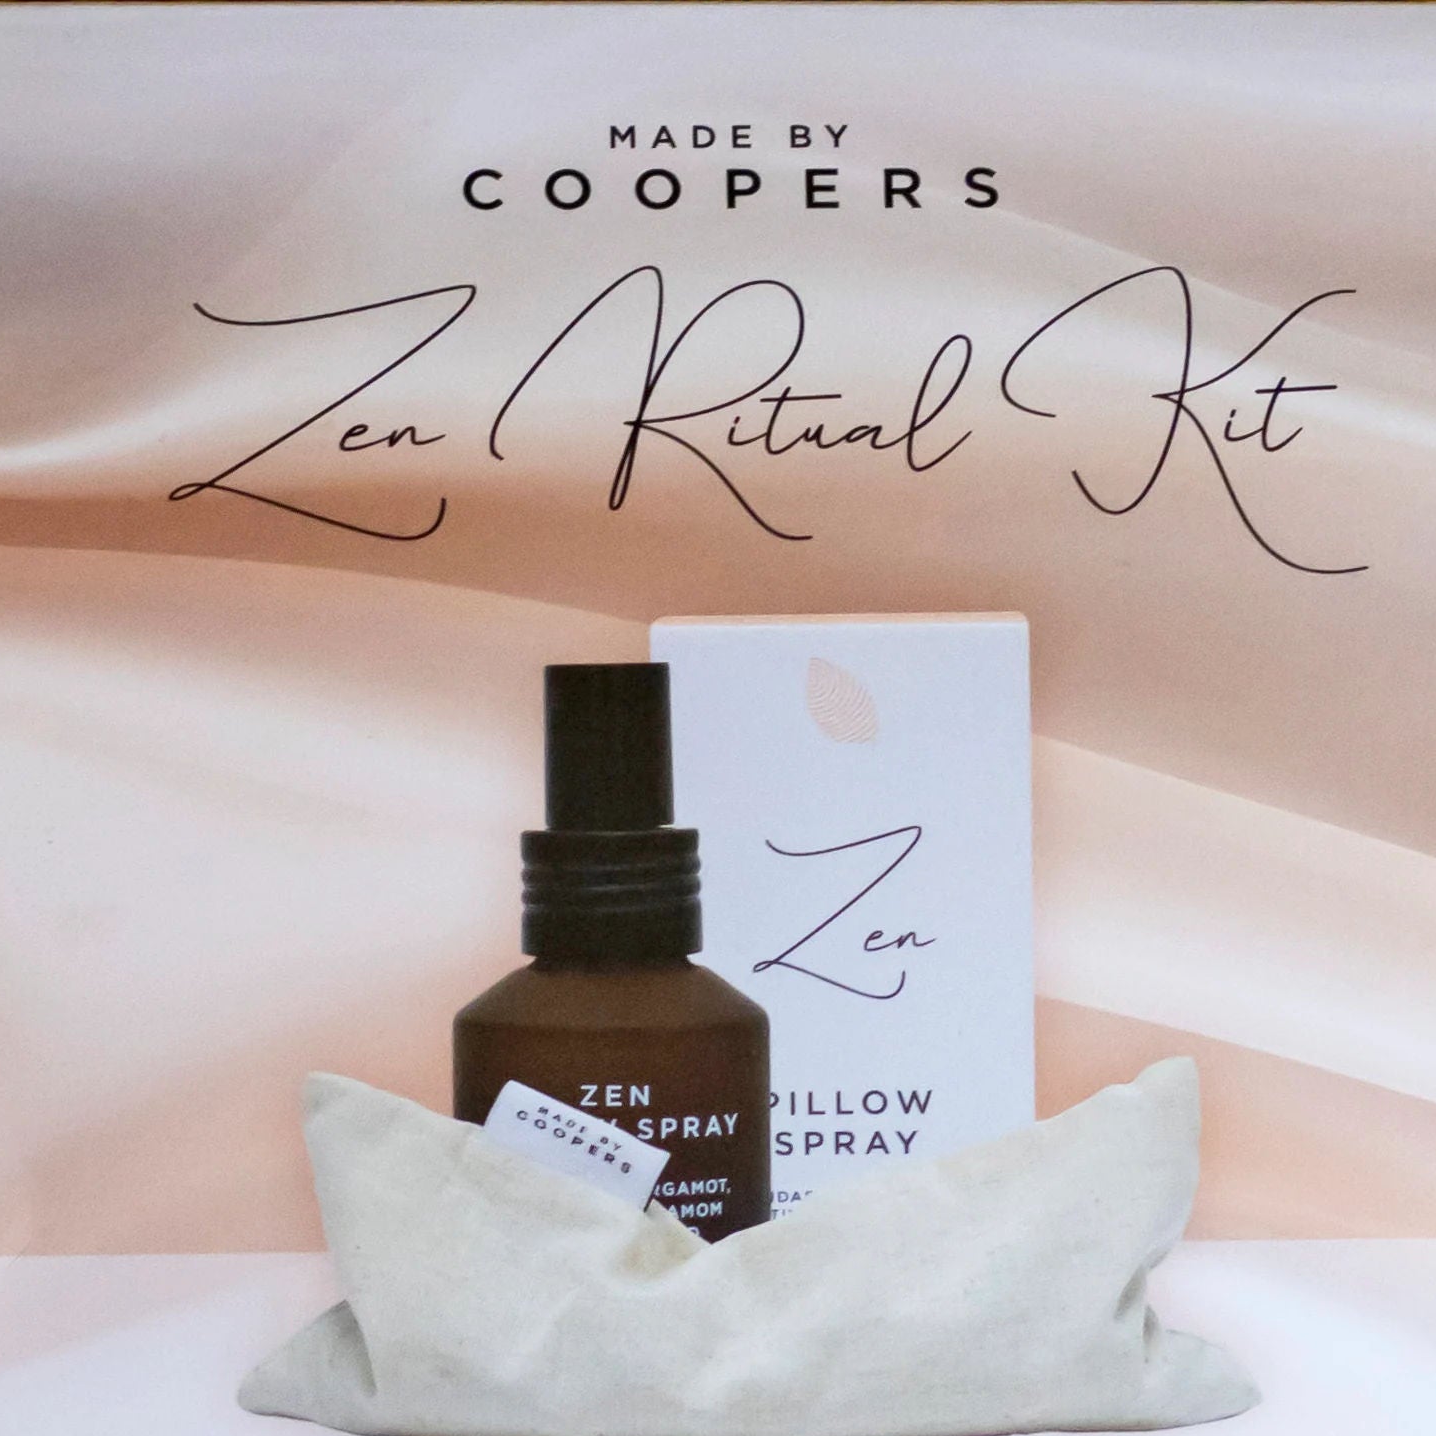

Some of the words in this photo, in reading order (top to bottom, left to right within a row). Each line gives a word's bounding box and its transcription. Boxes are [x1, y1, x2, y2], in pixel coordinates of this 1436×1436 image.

[609, 124, 755, 149] MADE
[790, 124, 850, 149] BY
[463, 167, 1001, 210] COOPERS
[168, 283, 477, 541] Zen
[489, 265, 972, 540] Ritual
[1001, 265, 1370, 573] Kit
[753, 825, 937, 999] Zen
[580, 1084, 650, 1107] ZEN
[516, 1110, 632, 1174] COOPERS
[637, 1113, 739, 1140] SPRAY
[775, 1130, 918, 1156] SPRAY
